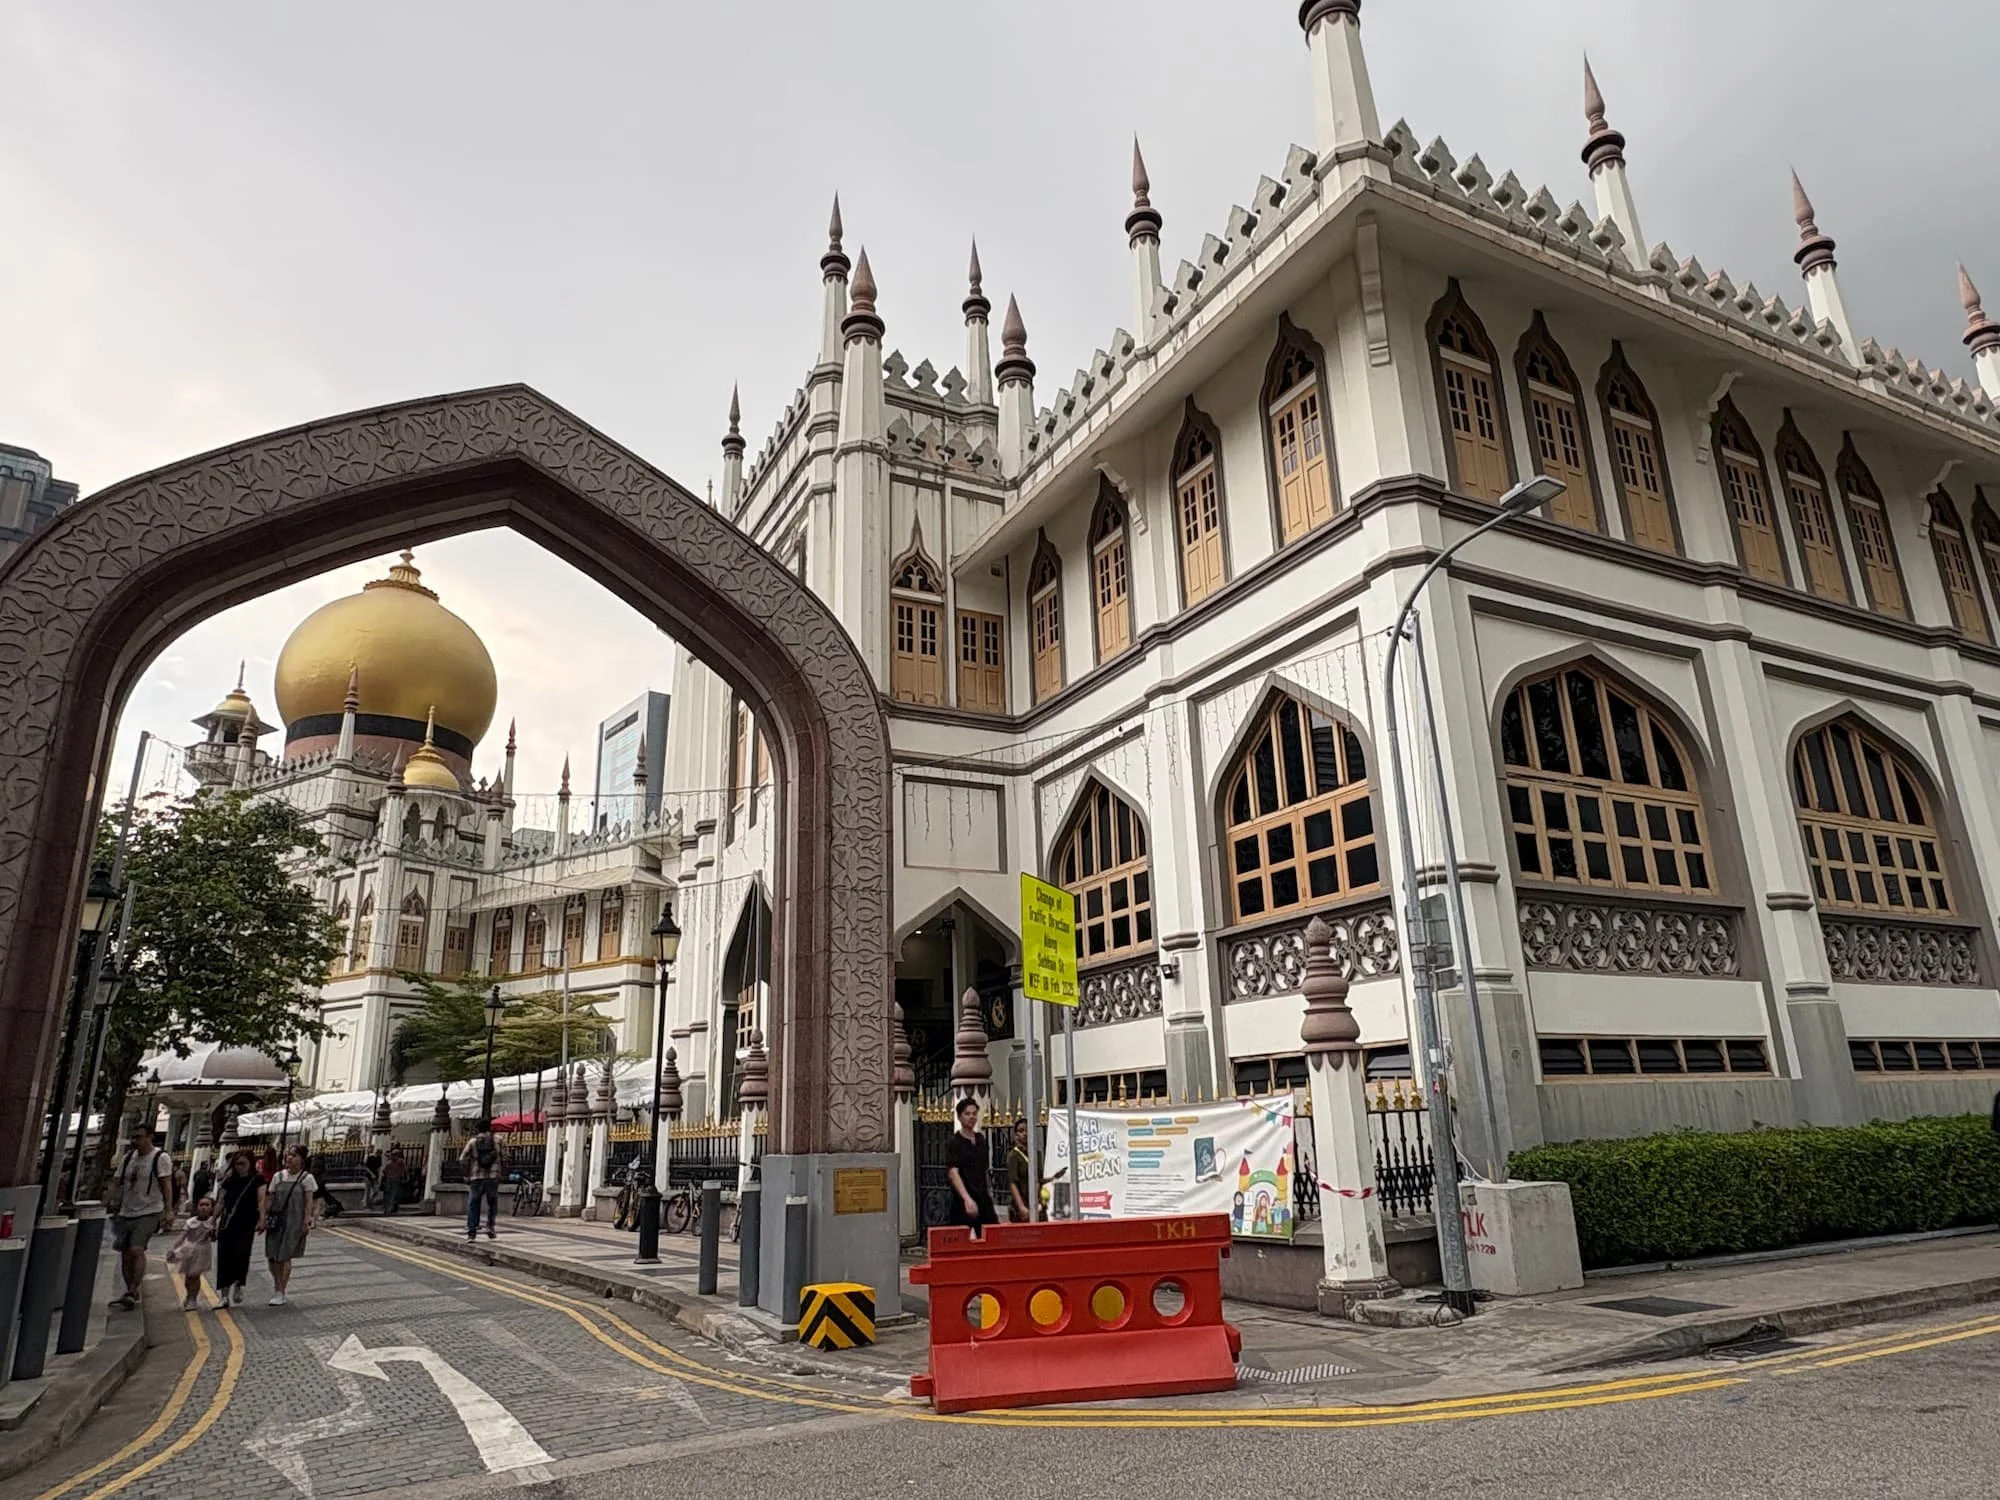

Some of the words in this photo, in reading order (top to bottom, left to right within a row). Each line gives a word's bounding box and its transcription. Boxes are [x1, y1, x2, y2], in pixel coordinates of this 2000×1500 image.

[1035, 887, 1054, 911] Change
[1056, 896, 1062, 910] of
[1029, 905, 1046, 926] Traffic
[1048, 912, 1070, 934] Direction
[1044, 932, 1057, 954] Along
[1058, 958, 1064, 974] St
[1051, 977, 1060, 993] Feb
[1152, 1220, 1196, 1240] TKH
